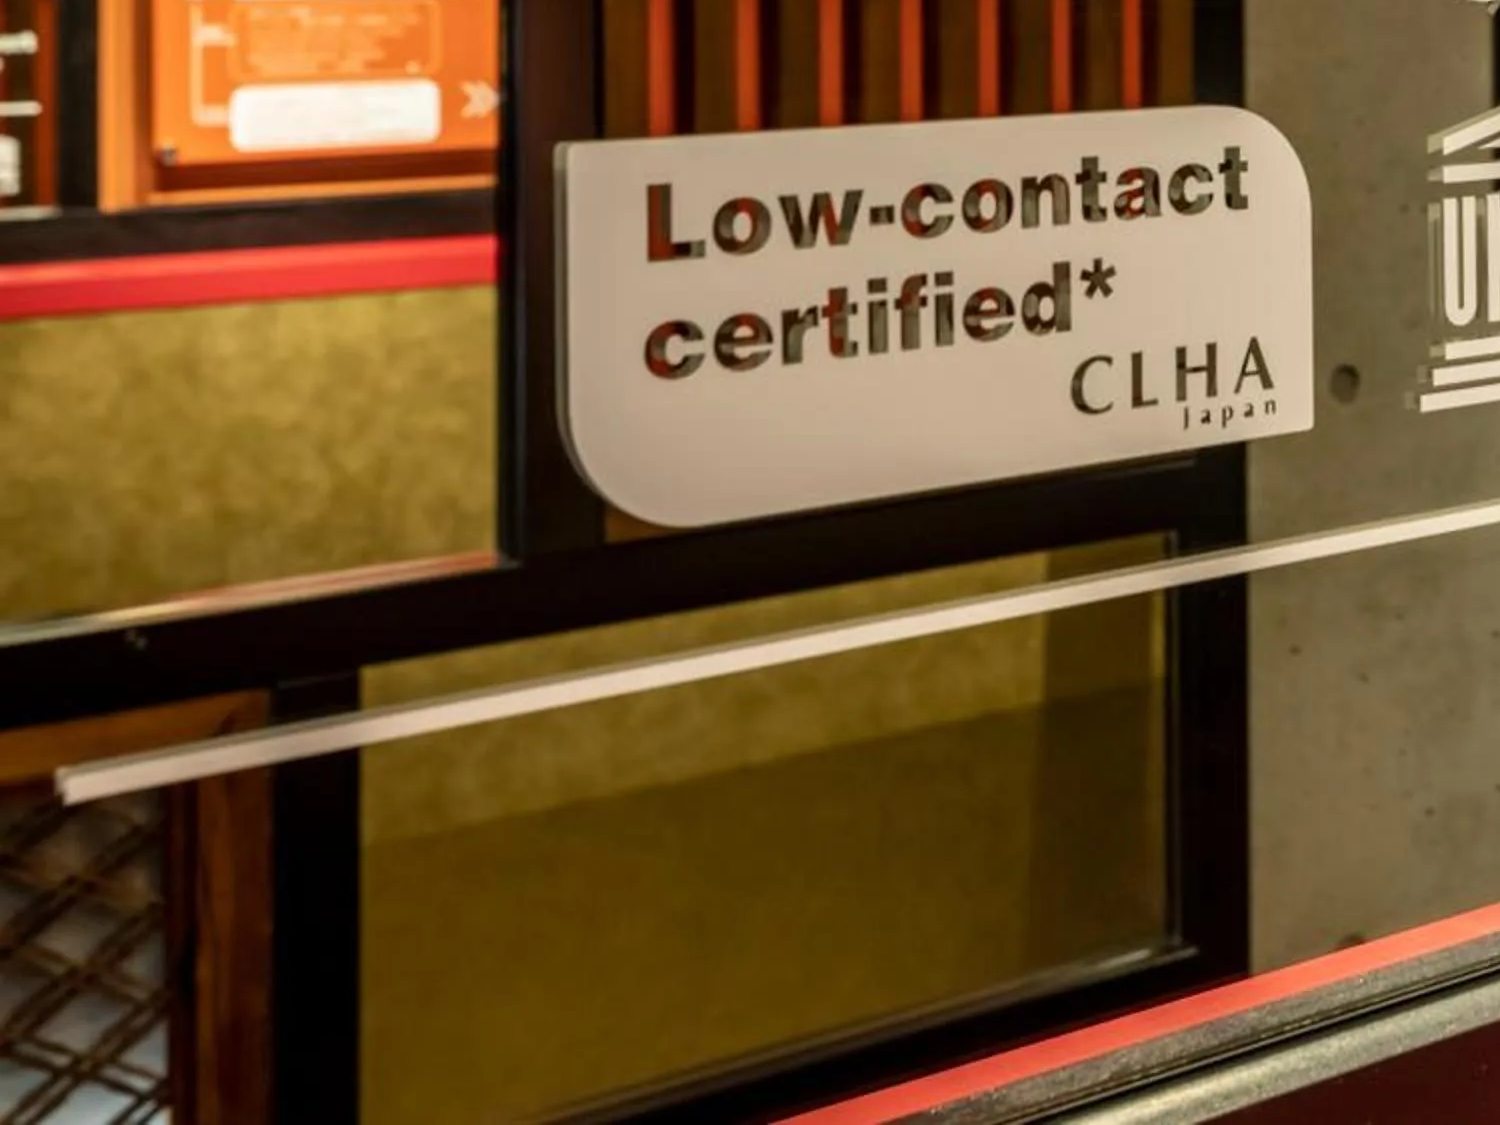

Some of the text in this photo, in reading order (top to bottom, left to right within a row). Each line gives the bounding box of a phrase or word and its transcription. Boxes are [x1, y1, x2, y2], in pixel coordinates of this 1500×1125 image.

[646, 145, 1249, 263] Low-contact
[1070, 336, 1275, 416] CLHA
[1182, 397, 1277, 430] Japan
